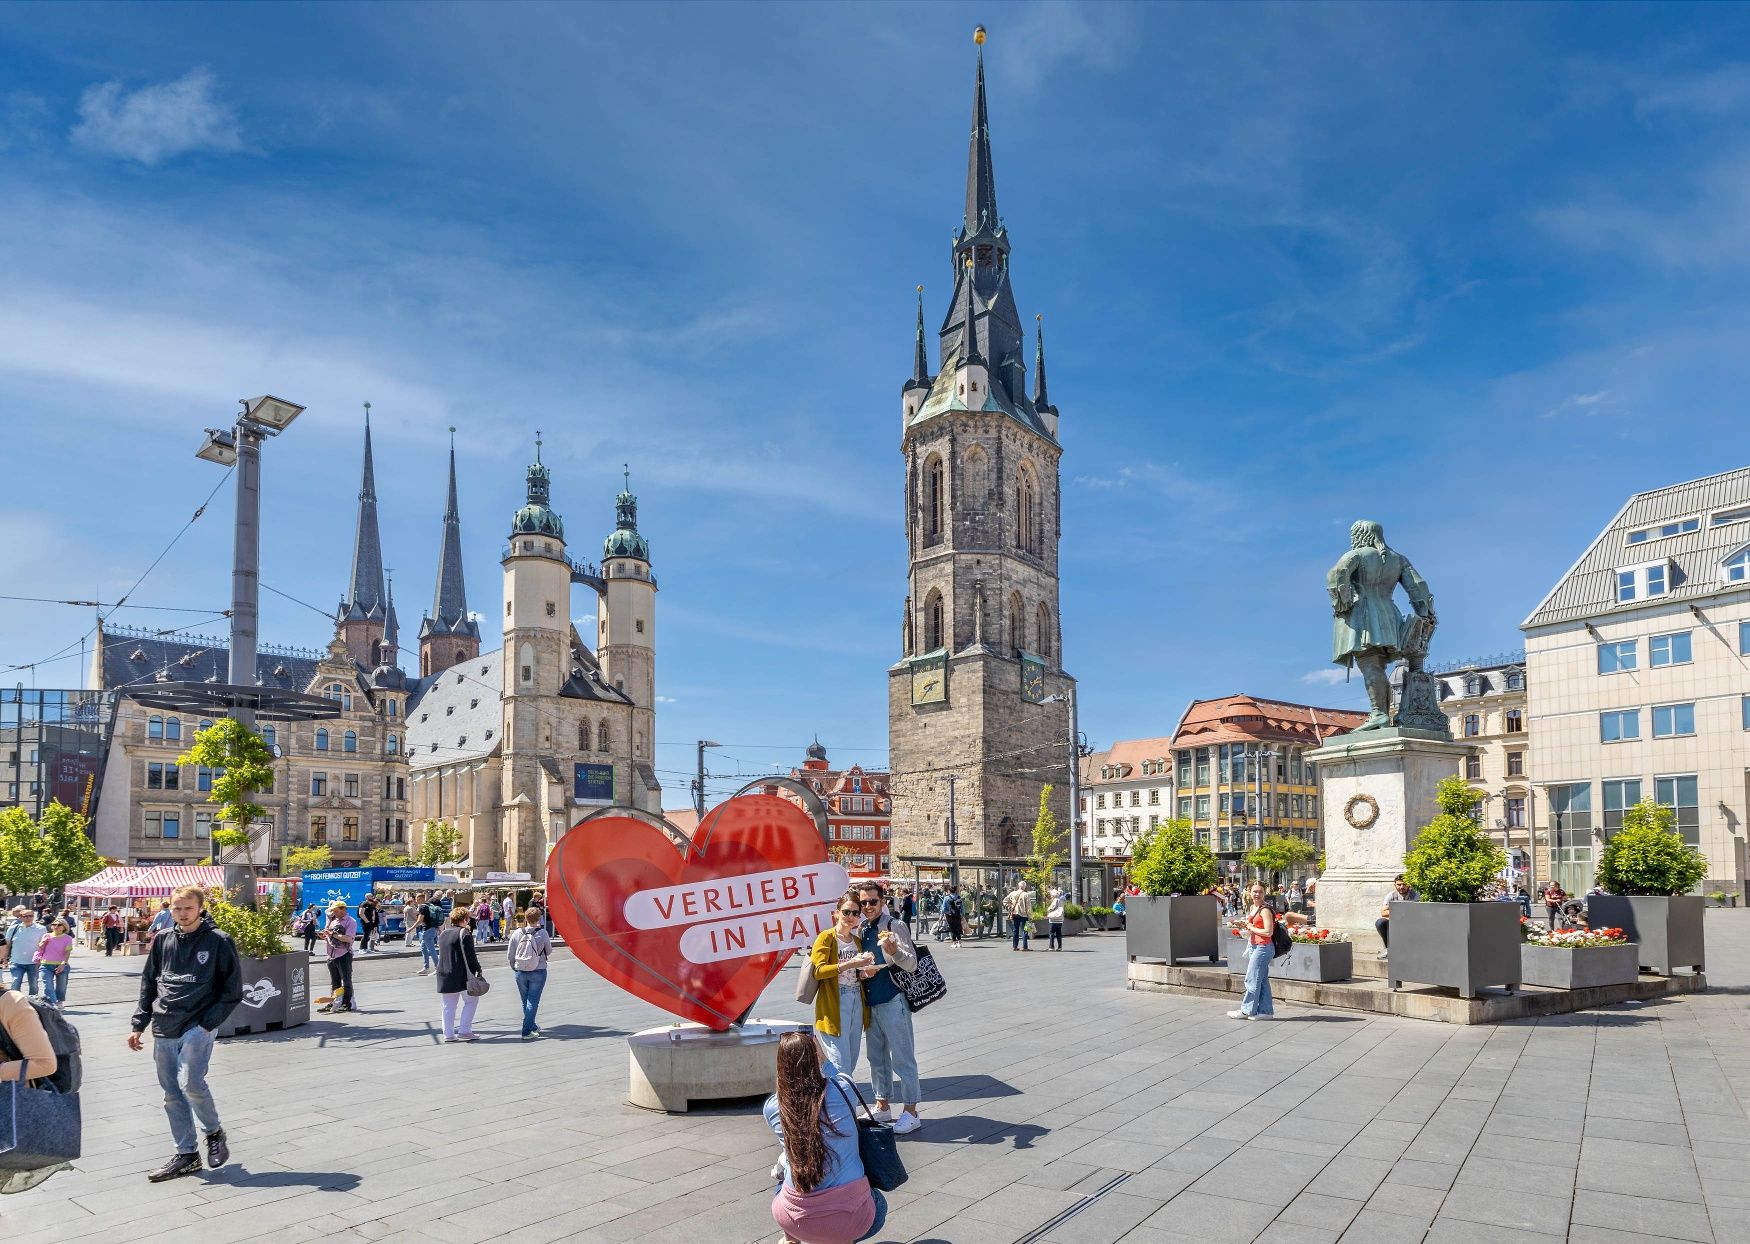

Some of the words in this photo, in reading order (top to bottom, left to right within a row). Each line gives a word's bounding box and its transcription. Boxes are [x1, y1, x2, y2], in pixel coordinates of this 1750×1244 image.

[322, 872, 343, 880] FEINKOST
[343, 871, 361, 879] GUTZEIT
[653, 872, 819, 920] VERLIEBT
[710, 926, 746, 953] IN
